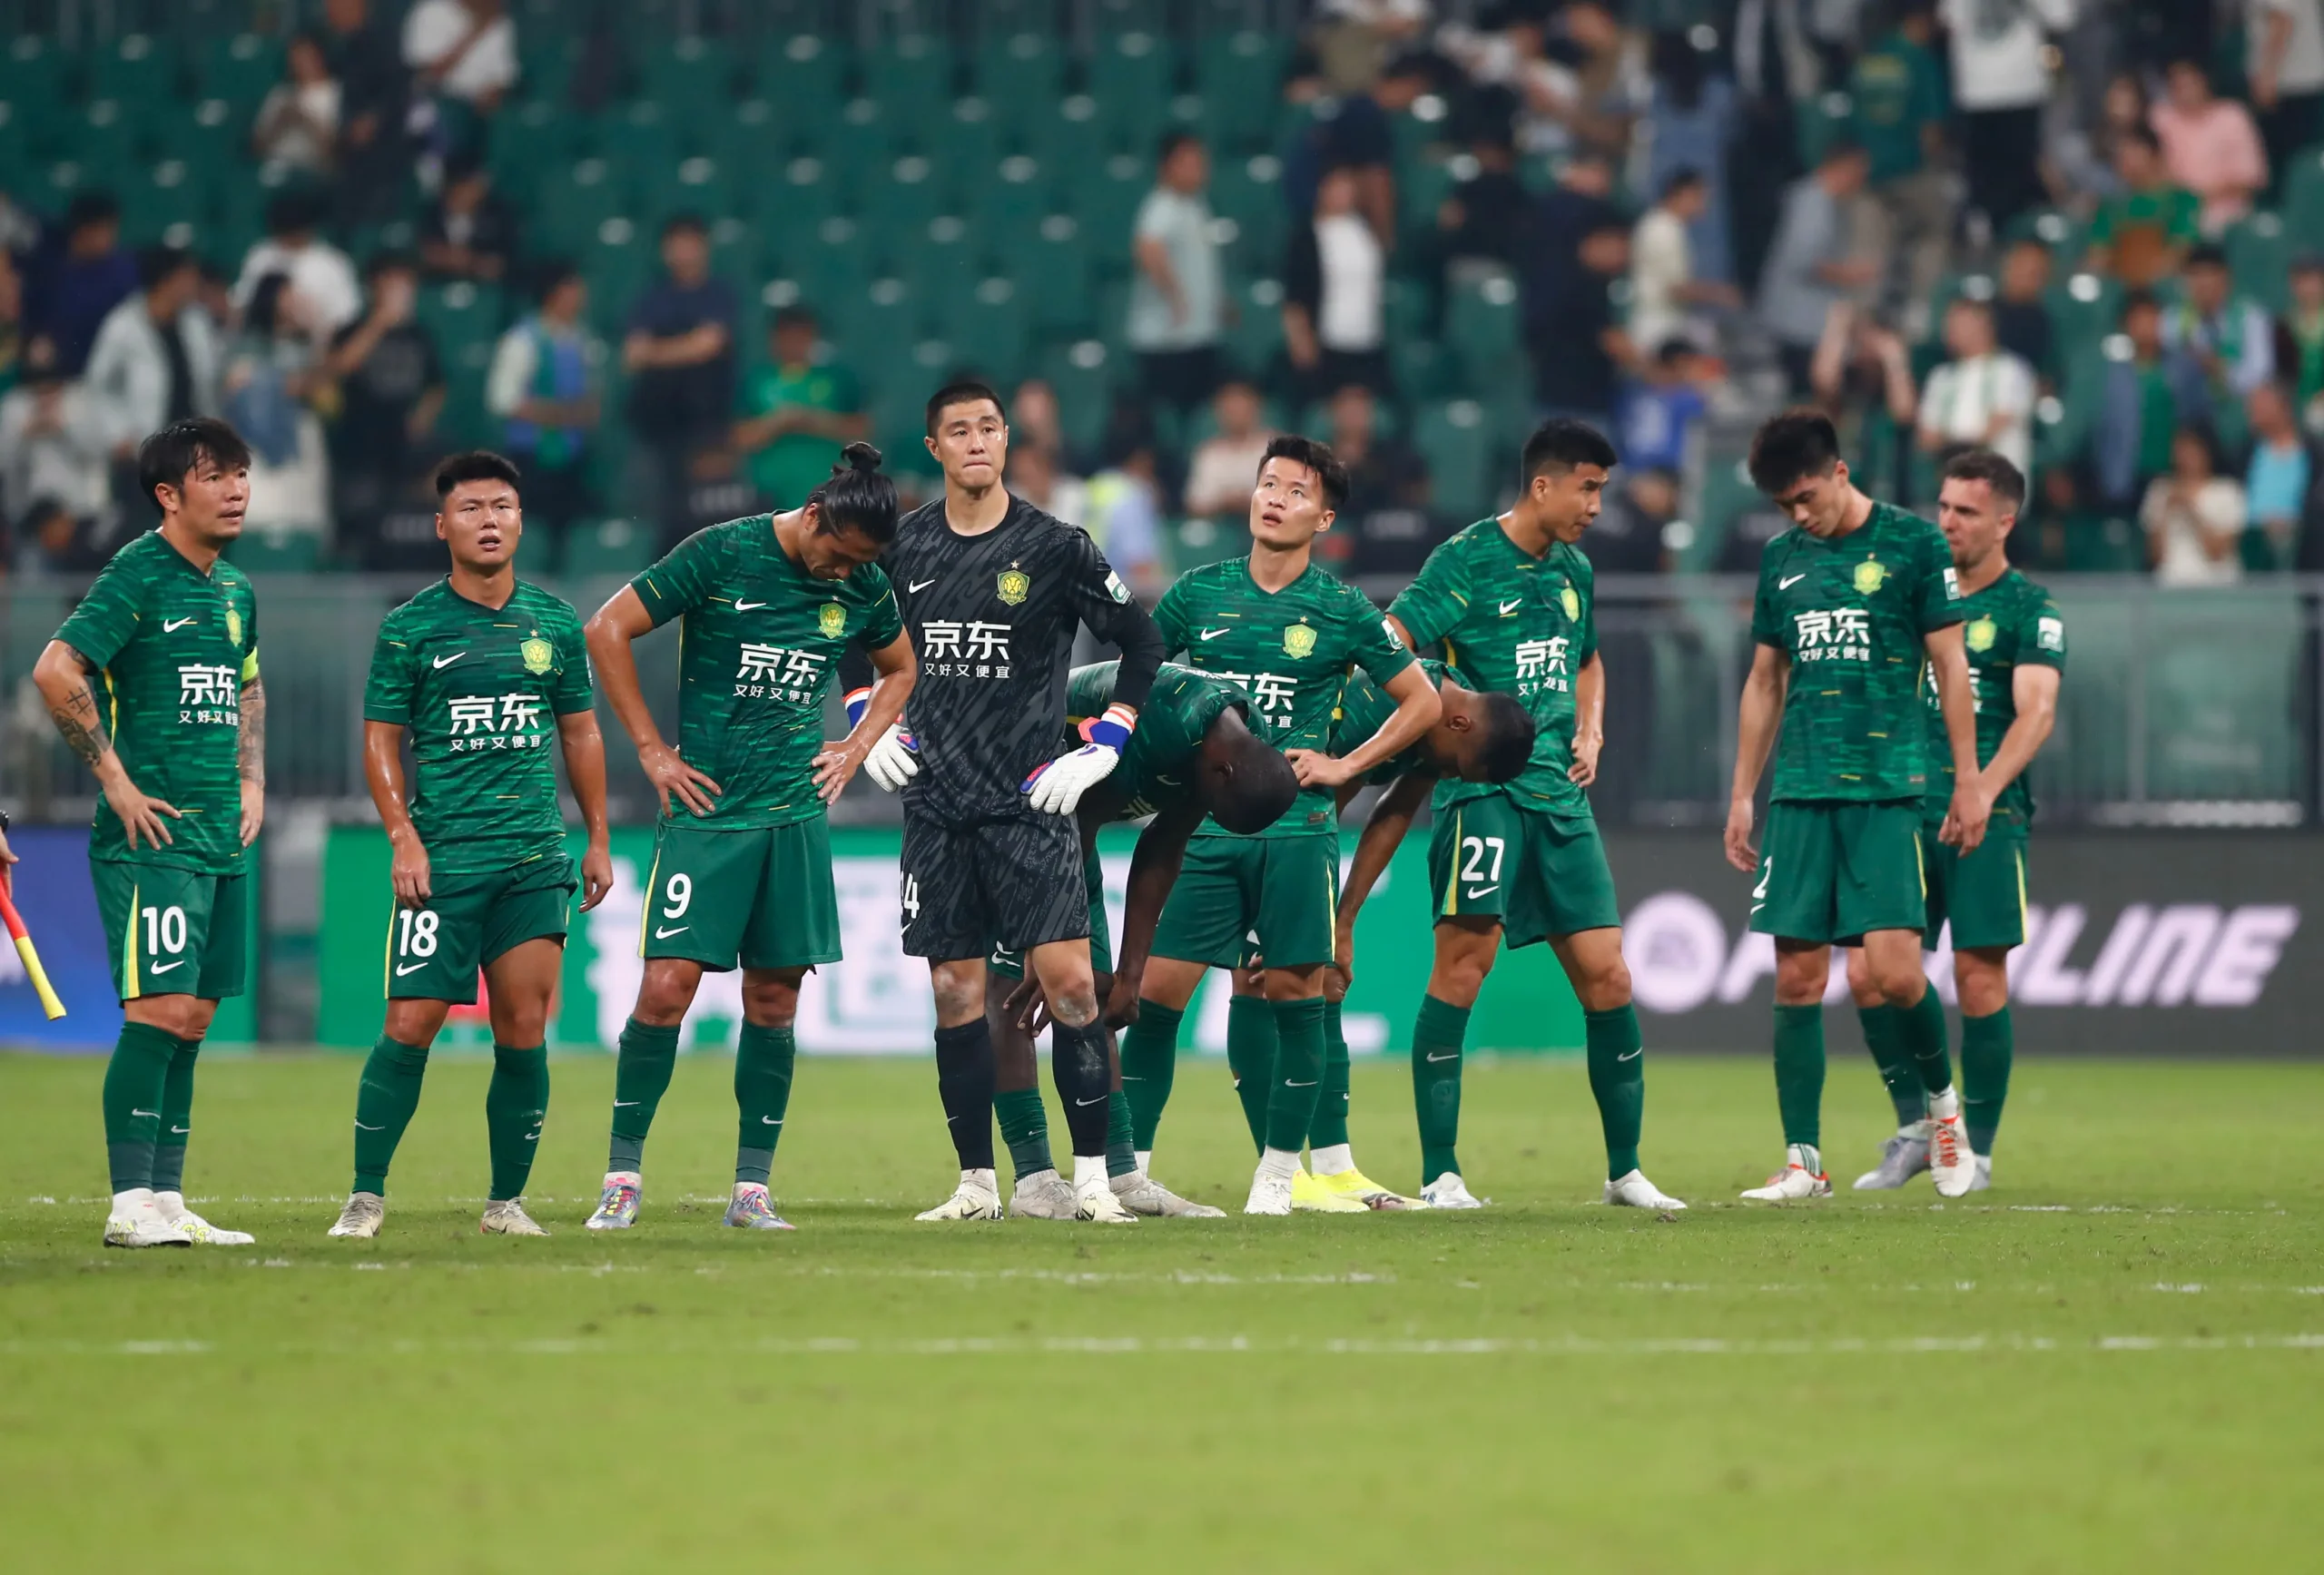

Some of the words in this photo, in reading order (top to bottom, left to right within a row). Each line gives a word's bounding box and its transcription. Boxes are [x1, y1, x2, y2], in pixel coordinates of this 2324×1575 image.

[922, 619, 1011, 660] 京东
[1795, 607, 1870, 649] 京东
[736, 643, 827, 687] 京东
[925, 663, 1009, 678] 又好又便宜
[1515, 636, 1569, 679] 京东
[1798, 646, 1870, 663] 又好又便宜
[178, 664, 236, 706] 京东
[733, 684, 812, 704] 又好又便宜
[178, 710, 238, 725] 又好又便宜
[448, 693, 540, 734] 京东
[449, 734, 541, 753] 又好又便宜
[1461, 836, 1504, 881] 27
[664, 872, 692, 919] 9
[142, 906, 186, 955] 10
[399, 909, 439, 957] 18
